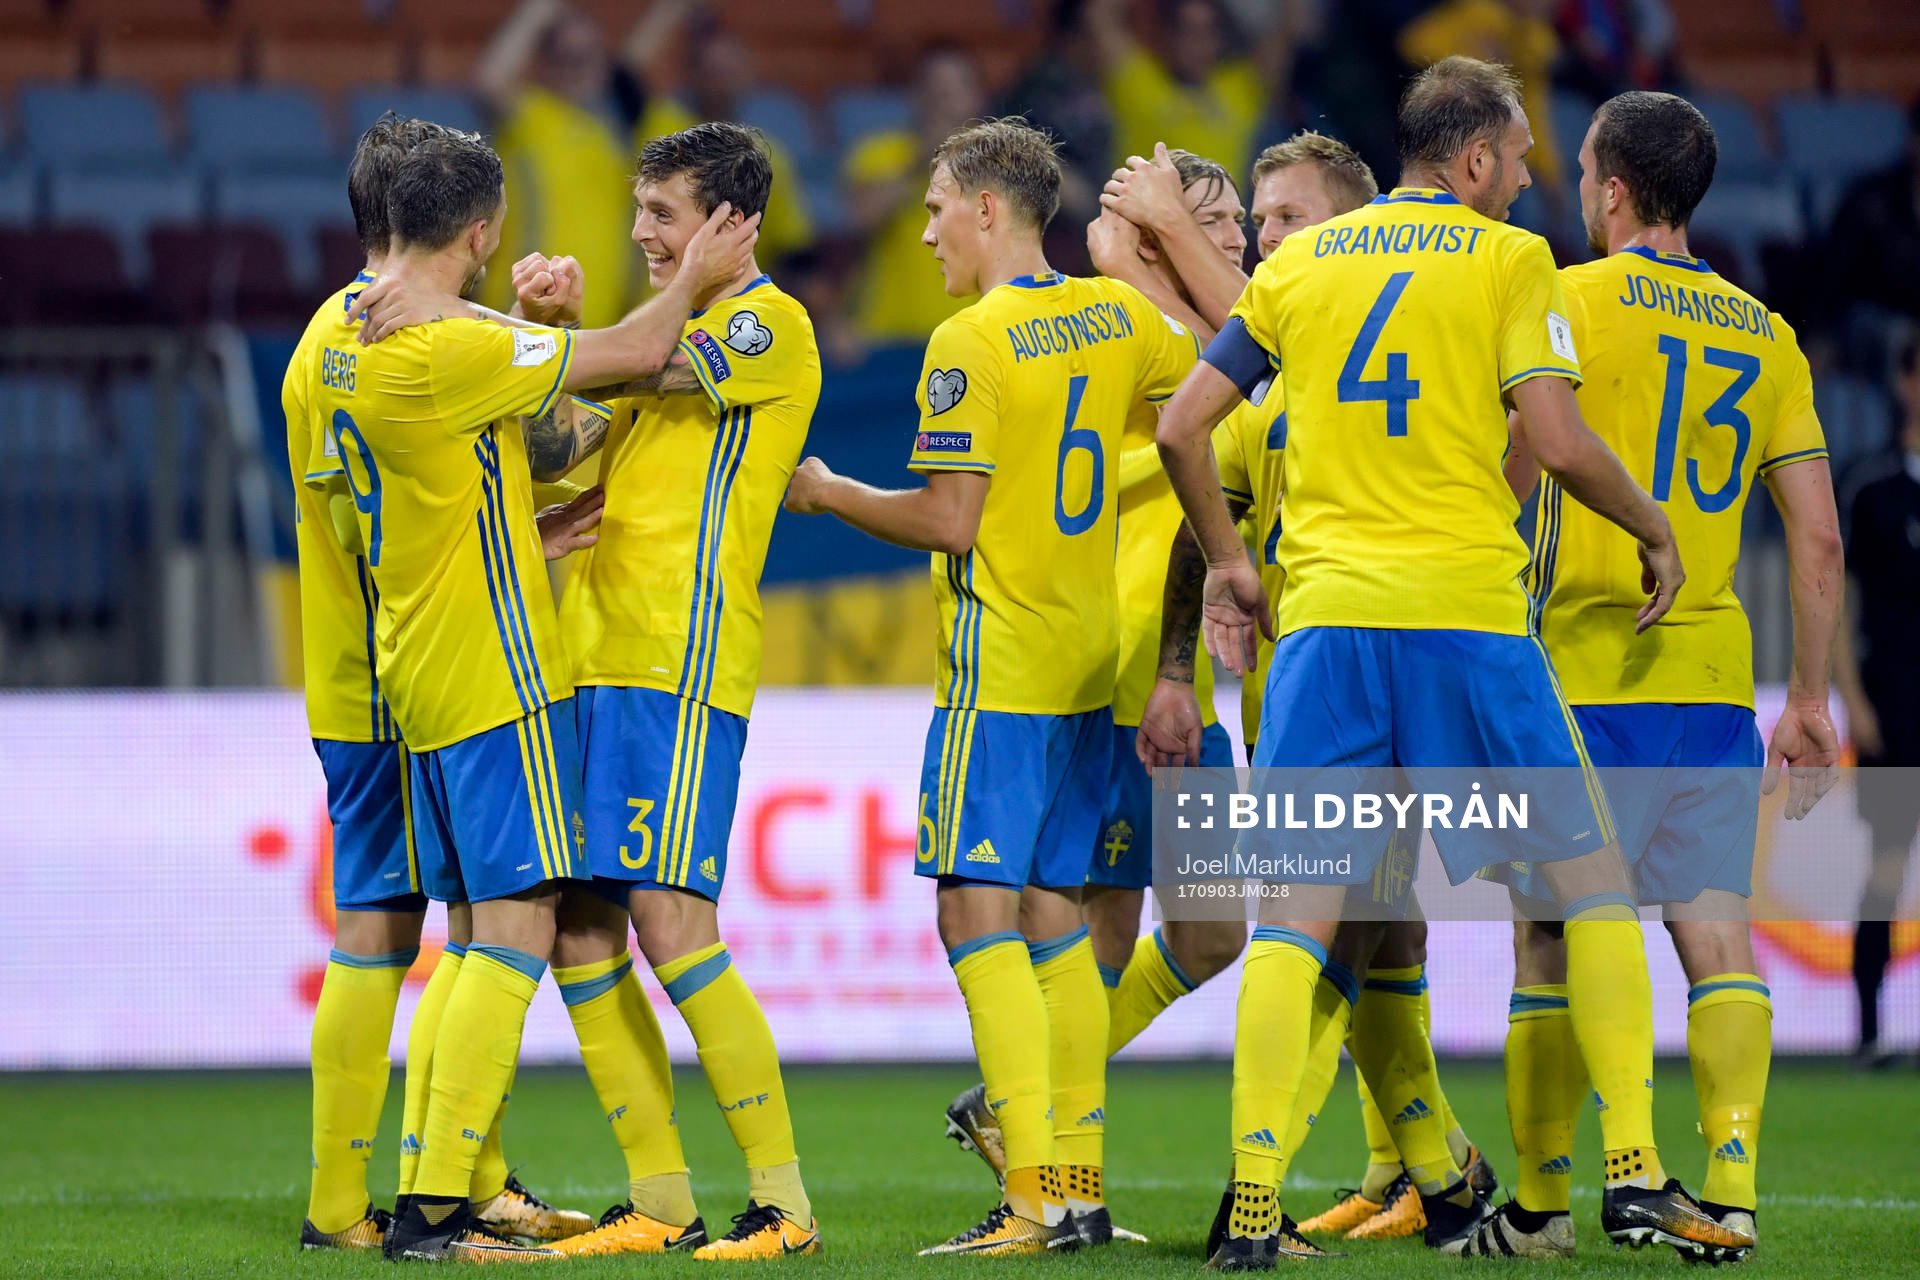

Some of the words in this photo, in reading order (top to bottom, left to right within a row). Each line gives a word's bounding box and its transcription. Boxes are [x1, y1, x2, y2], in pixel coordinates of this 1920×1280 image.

[1314, 223, 1486, 258] GRANQVIST
[1619, 274, 1775, 342] JOHANSSON
[322, 347, 356, 392] BERG
[702, 341, 727, 380] RESPECT
[1337, 271, 1420, 437] 4
[930, 436, 970, 447] RESPECT
[1054, 376, 1105, 536] 6
[1652, 333, 1761, 513] 13
[332, 409, 382, 567] 9
[619, 797, 654, 869] 3
[917, 793, 936, 863] 6
[965, 853, 1000, 864] adidas
[1714, 1151, 1750, 1165] adidas
